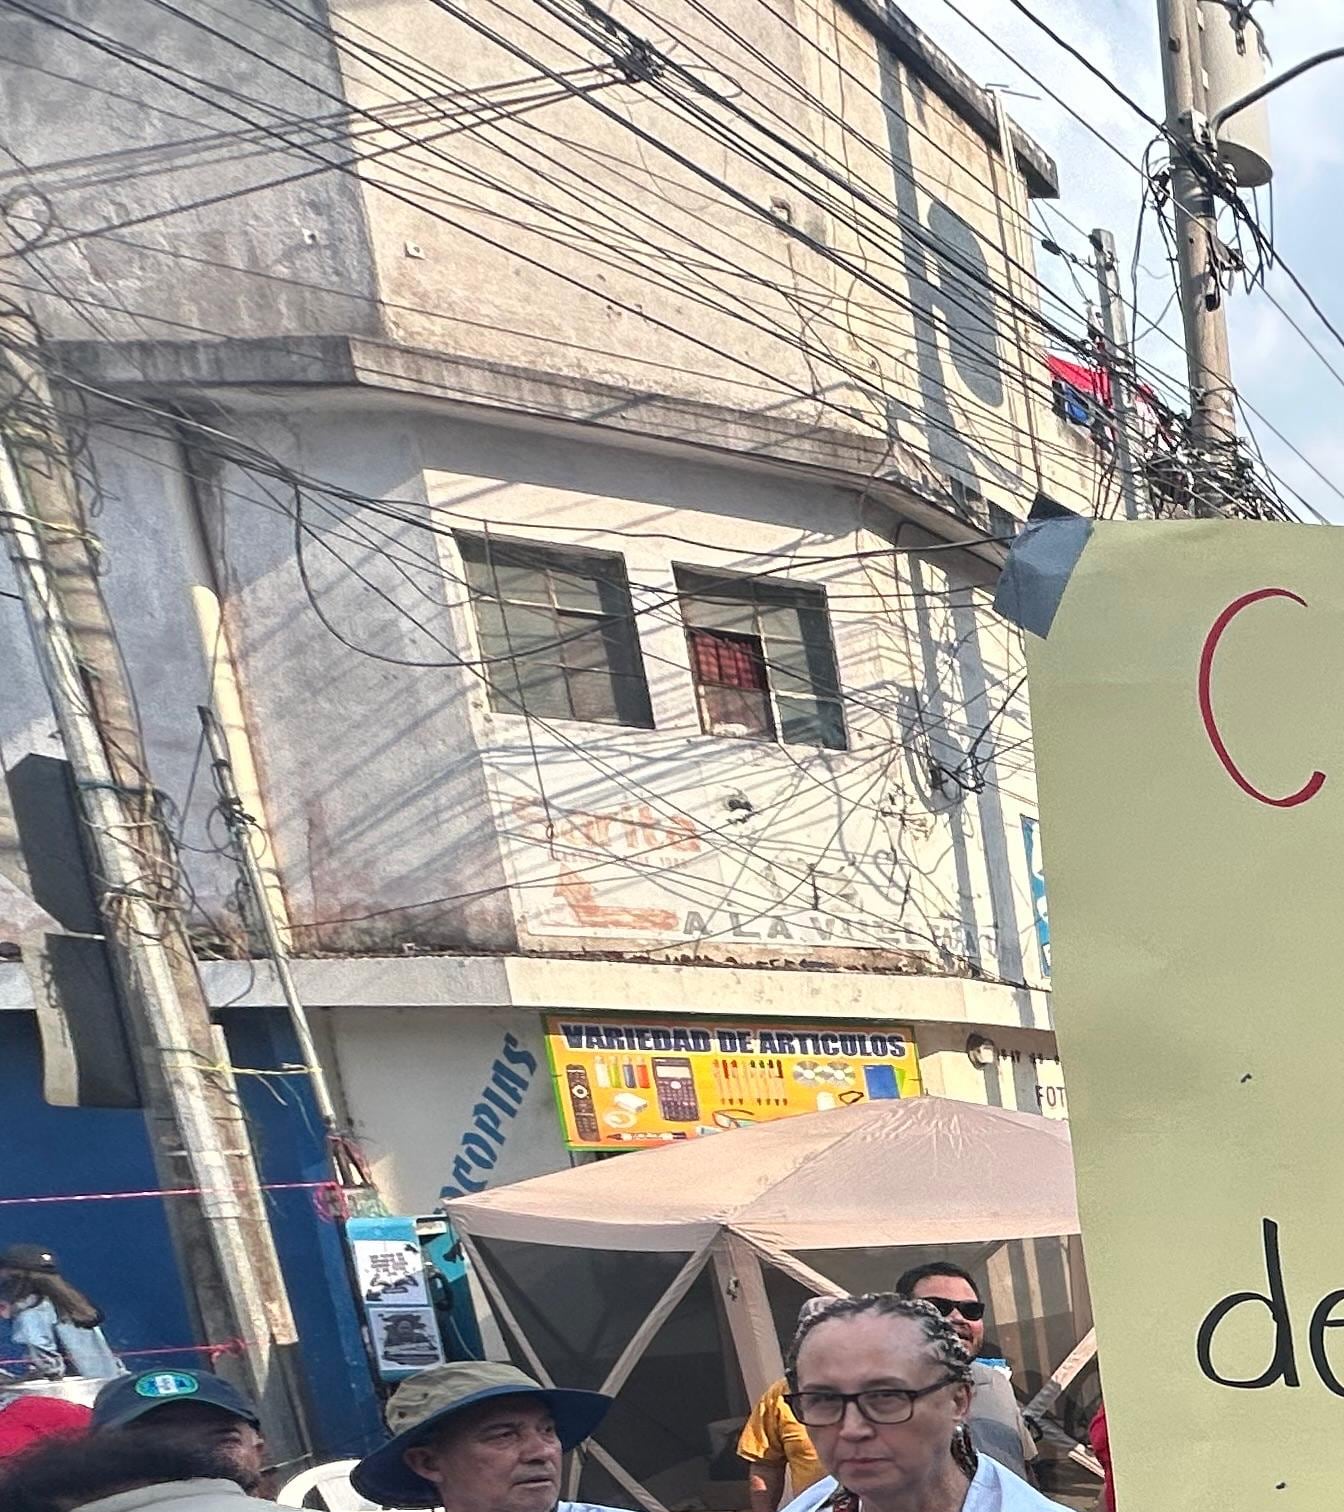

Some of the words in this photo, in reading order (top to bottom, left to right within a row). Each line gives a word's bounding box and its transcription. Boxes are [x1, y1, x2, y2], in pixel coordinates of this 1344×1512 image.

[560, 1022, 712, 1052] VARIEDAD
[716, 1028, 754, 1054] DE
[758, 1030, 907, 1058] ARTICULOS
